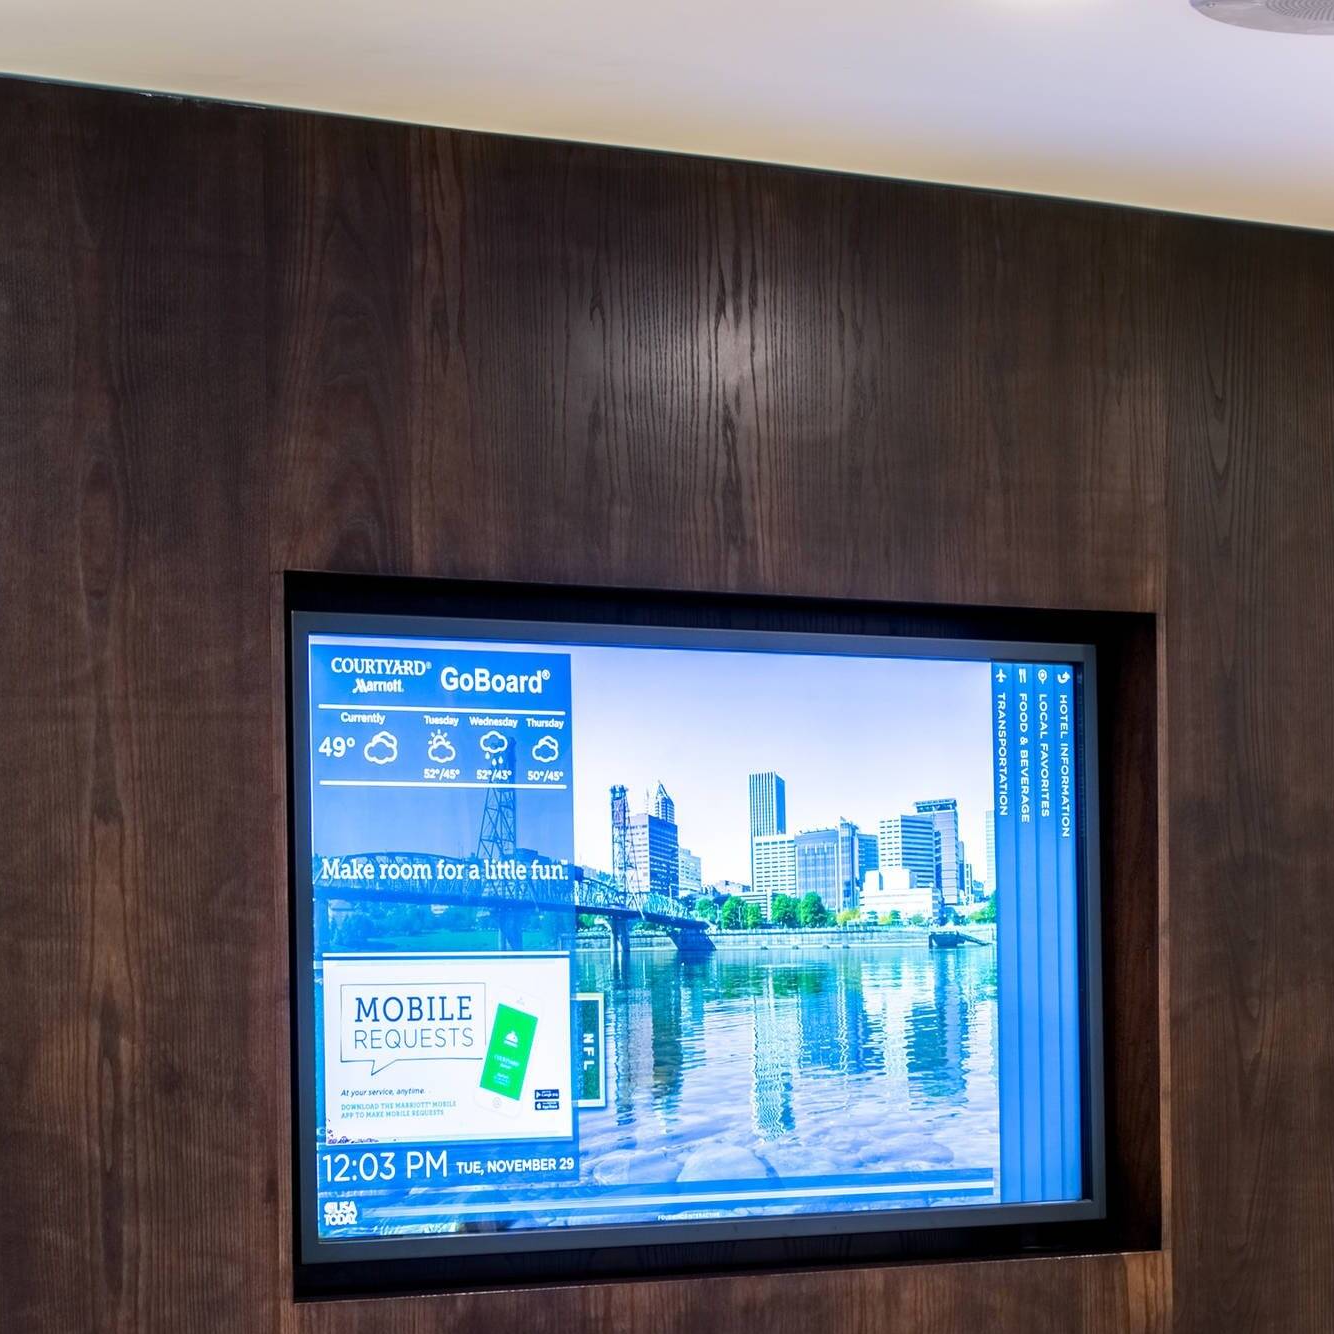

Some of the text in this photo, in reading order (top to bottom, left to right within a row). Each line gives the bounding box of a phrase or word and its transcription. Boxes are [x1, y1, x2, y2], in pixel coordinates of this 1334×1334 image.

[340, 712, 385, 725] Currently
[424, 715, 459, 726] Tuesday
[469, 715, 518, 728] Wednesday
[526, 717, 564, 729] Thursday
[997, 692, 1008, 816] TRANSPORTATION
[1019, 693, 1030, 823] FOOD & BEVERAGE
[1038, 694, 1050, 817] LOCAL FAVORITES
[1059, 694, 1070, 838] HOTEL INFORMATION
[321, 858, 375, 880] Make
[379, 862, 432, 880] room
[436, 859, 464, 880] for
[469, 864, 480, 880] a
[485, 859, 527, 880] little
[355, 995, 473, 1022] MOBILE
[354, 1027, 474, 1049] REQUESTS
[583, 1033, 595, 1071] NFL
[351, 1090, 367, 1098] your
[368, 1088, 395, 1096] service,
[341, 1103, 380, 1111] DOWNLOAD
[432, 1100, 457, 1108] MOBILE
[341, 1111, 354, 1119] APP
[366, 1110, 385, 1118] MAKE
[323, 1150, 575, 1182] 12:03 PM TUE, NOVEMBER 29
